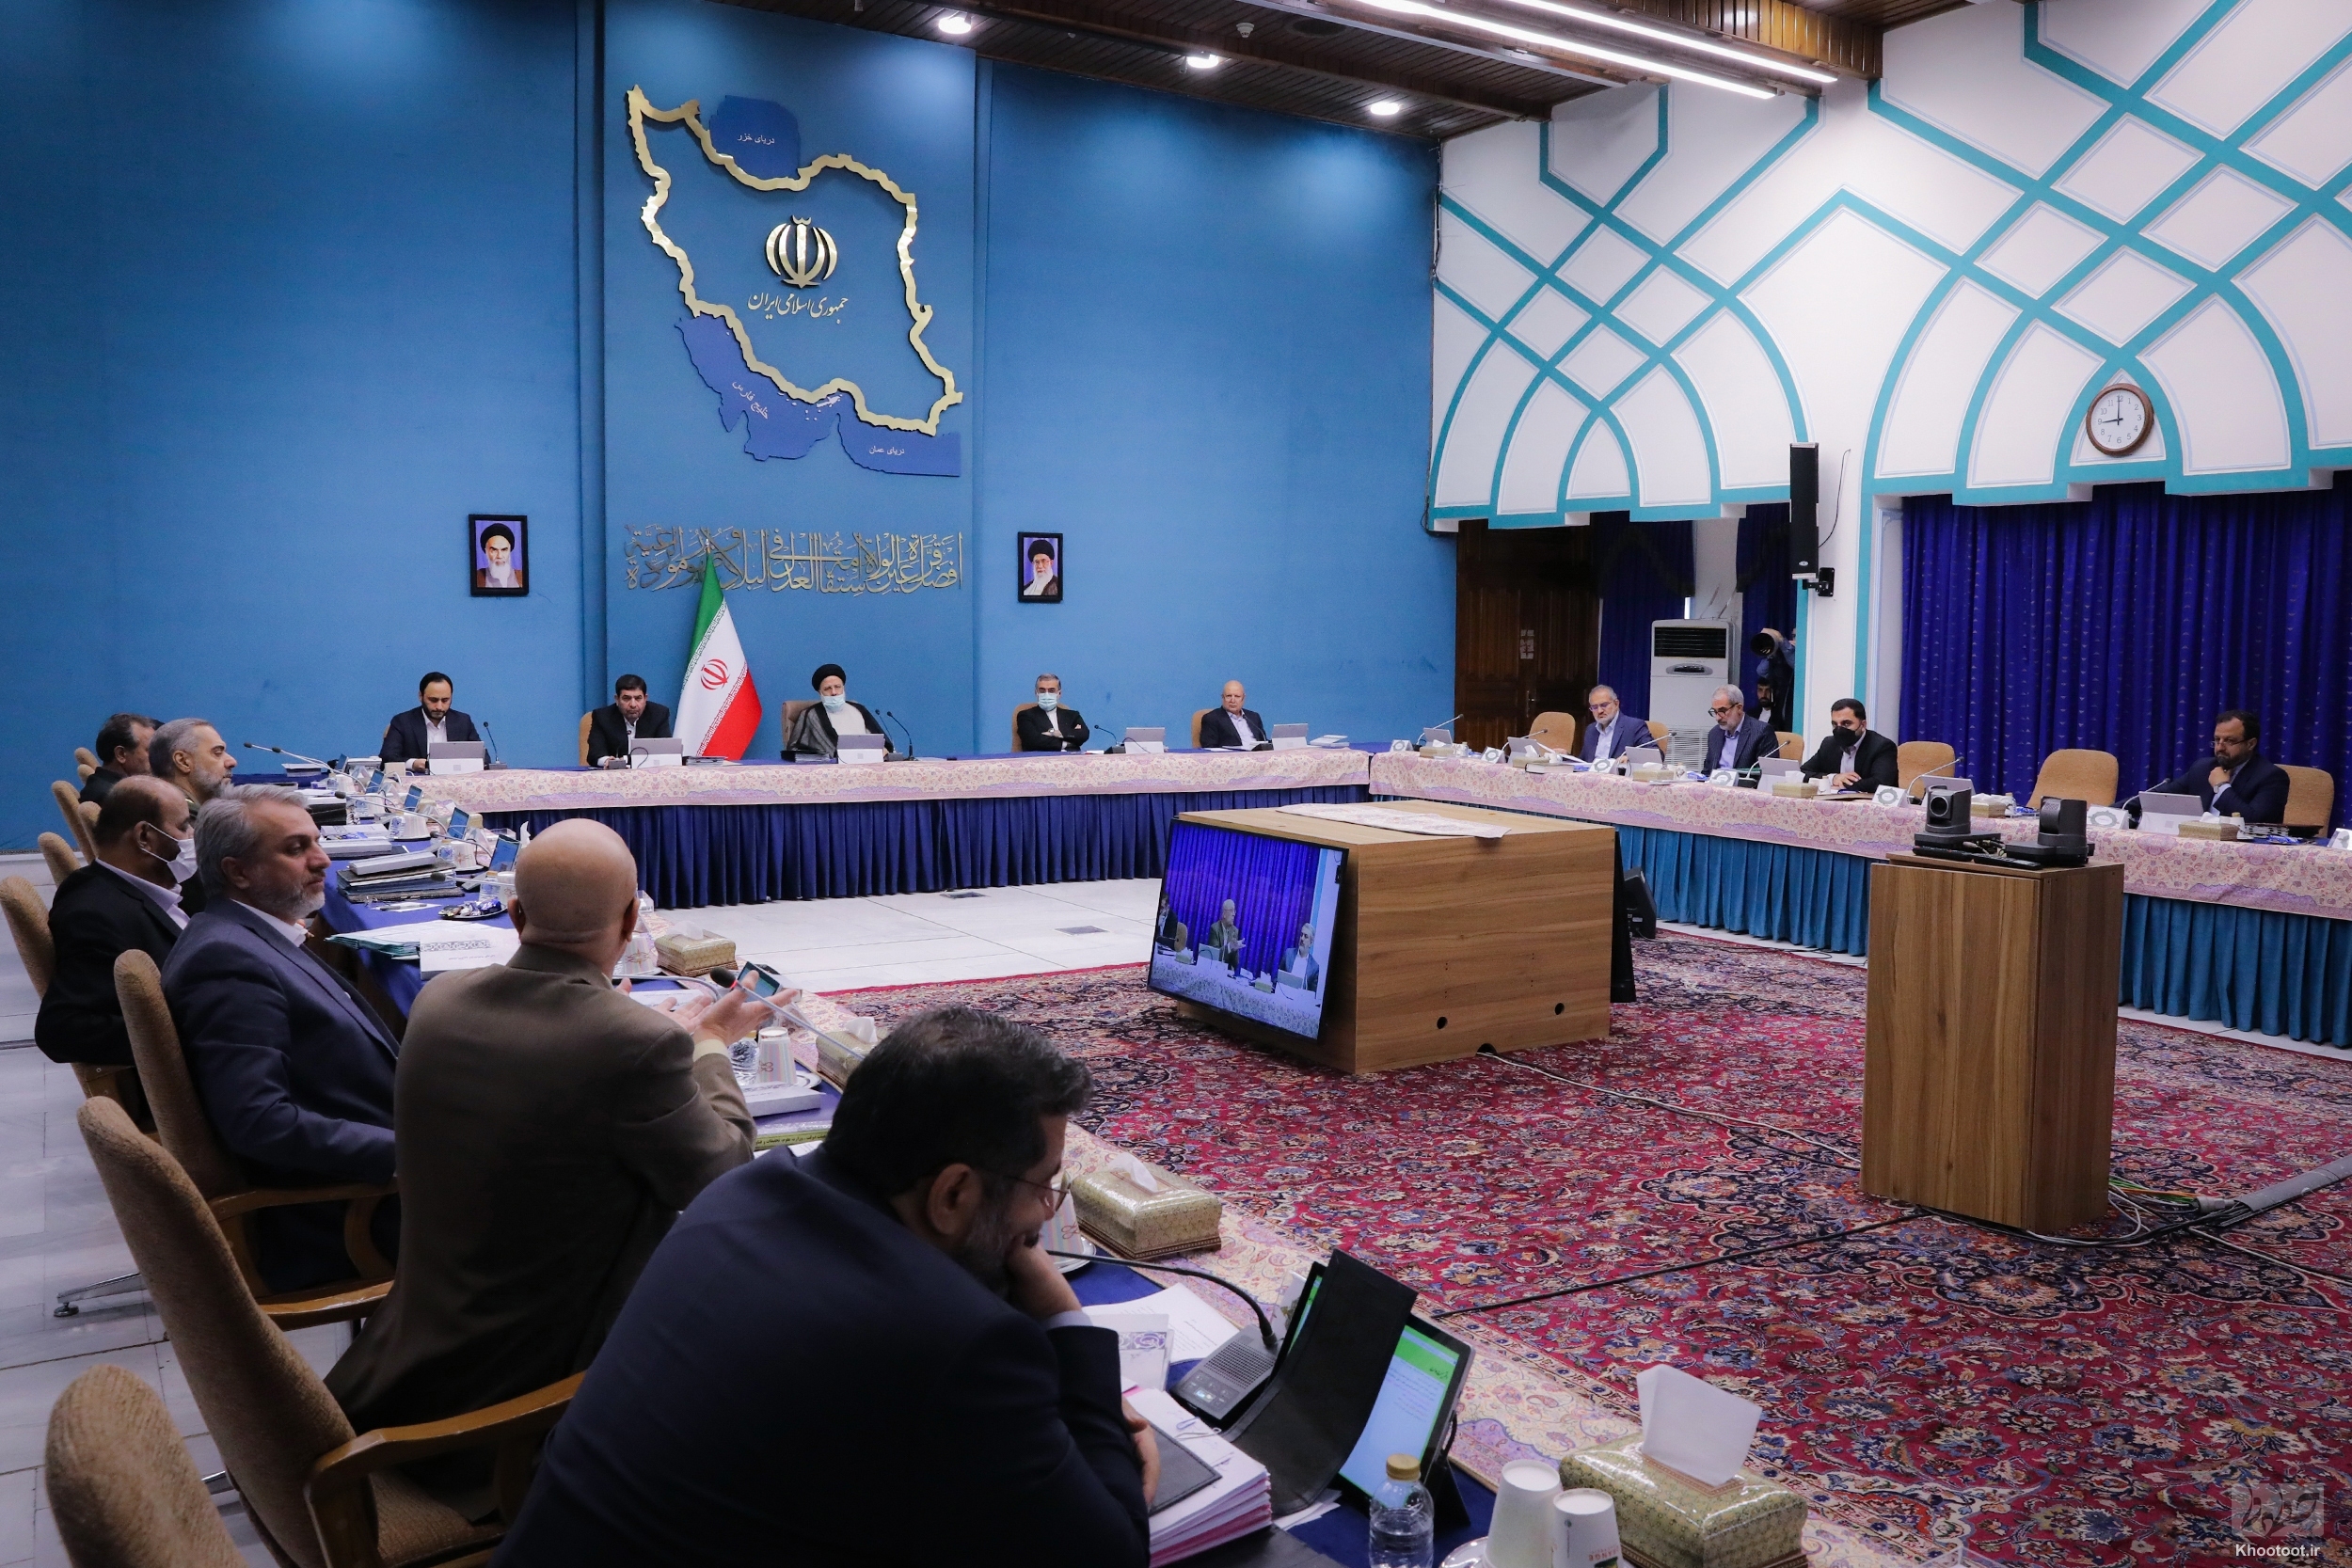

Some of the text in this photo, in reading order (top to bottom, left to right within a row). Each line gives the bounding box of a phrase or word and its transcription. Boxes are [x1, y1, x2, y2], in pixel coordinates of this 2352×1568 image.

[737, 133, 775, 146] دریای خزر
[747, 292, 849, 325] جمهوری اسلامی ایران
[732, 381, 768, 420] خلیج فارس
[868, 445, 905, 456] دریای عمان
